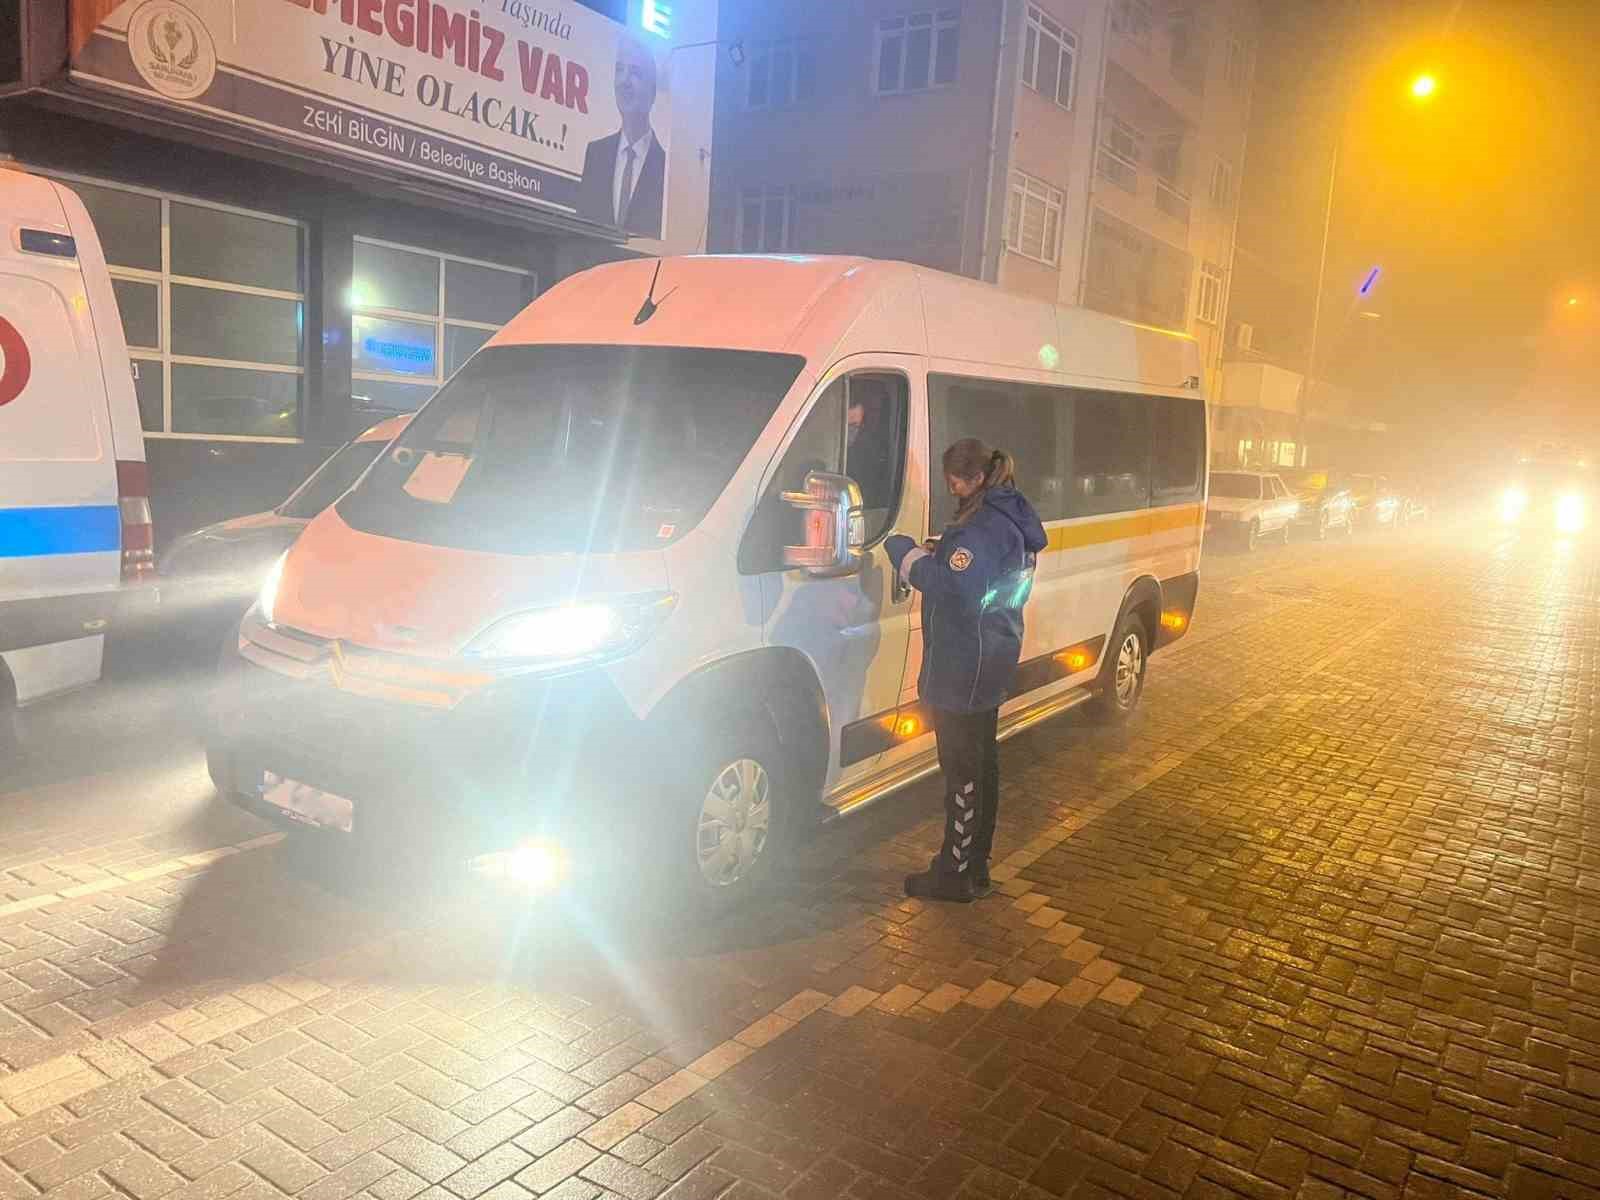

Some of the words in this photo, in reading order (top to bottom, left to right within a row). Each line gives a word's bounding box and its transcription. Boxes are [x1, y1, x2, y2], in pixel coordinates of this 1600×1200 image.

[320, 35, 406, 97] YİNE
[416, 74, 568, 151] OLACAK...!
[518, 40, 589, 114] VAR
[303, 105, 343, 135] ZEKİ
[348, 118, 405, 153] BİLGİN
[408, 137, 417, 159] /
[420, 141, 485, 177] Belediye
[488, 162, 542, 193] Başkanı
